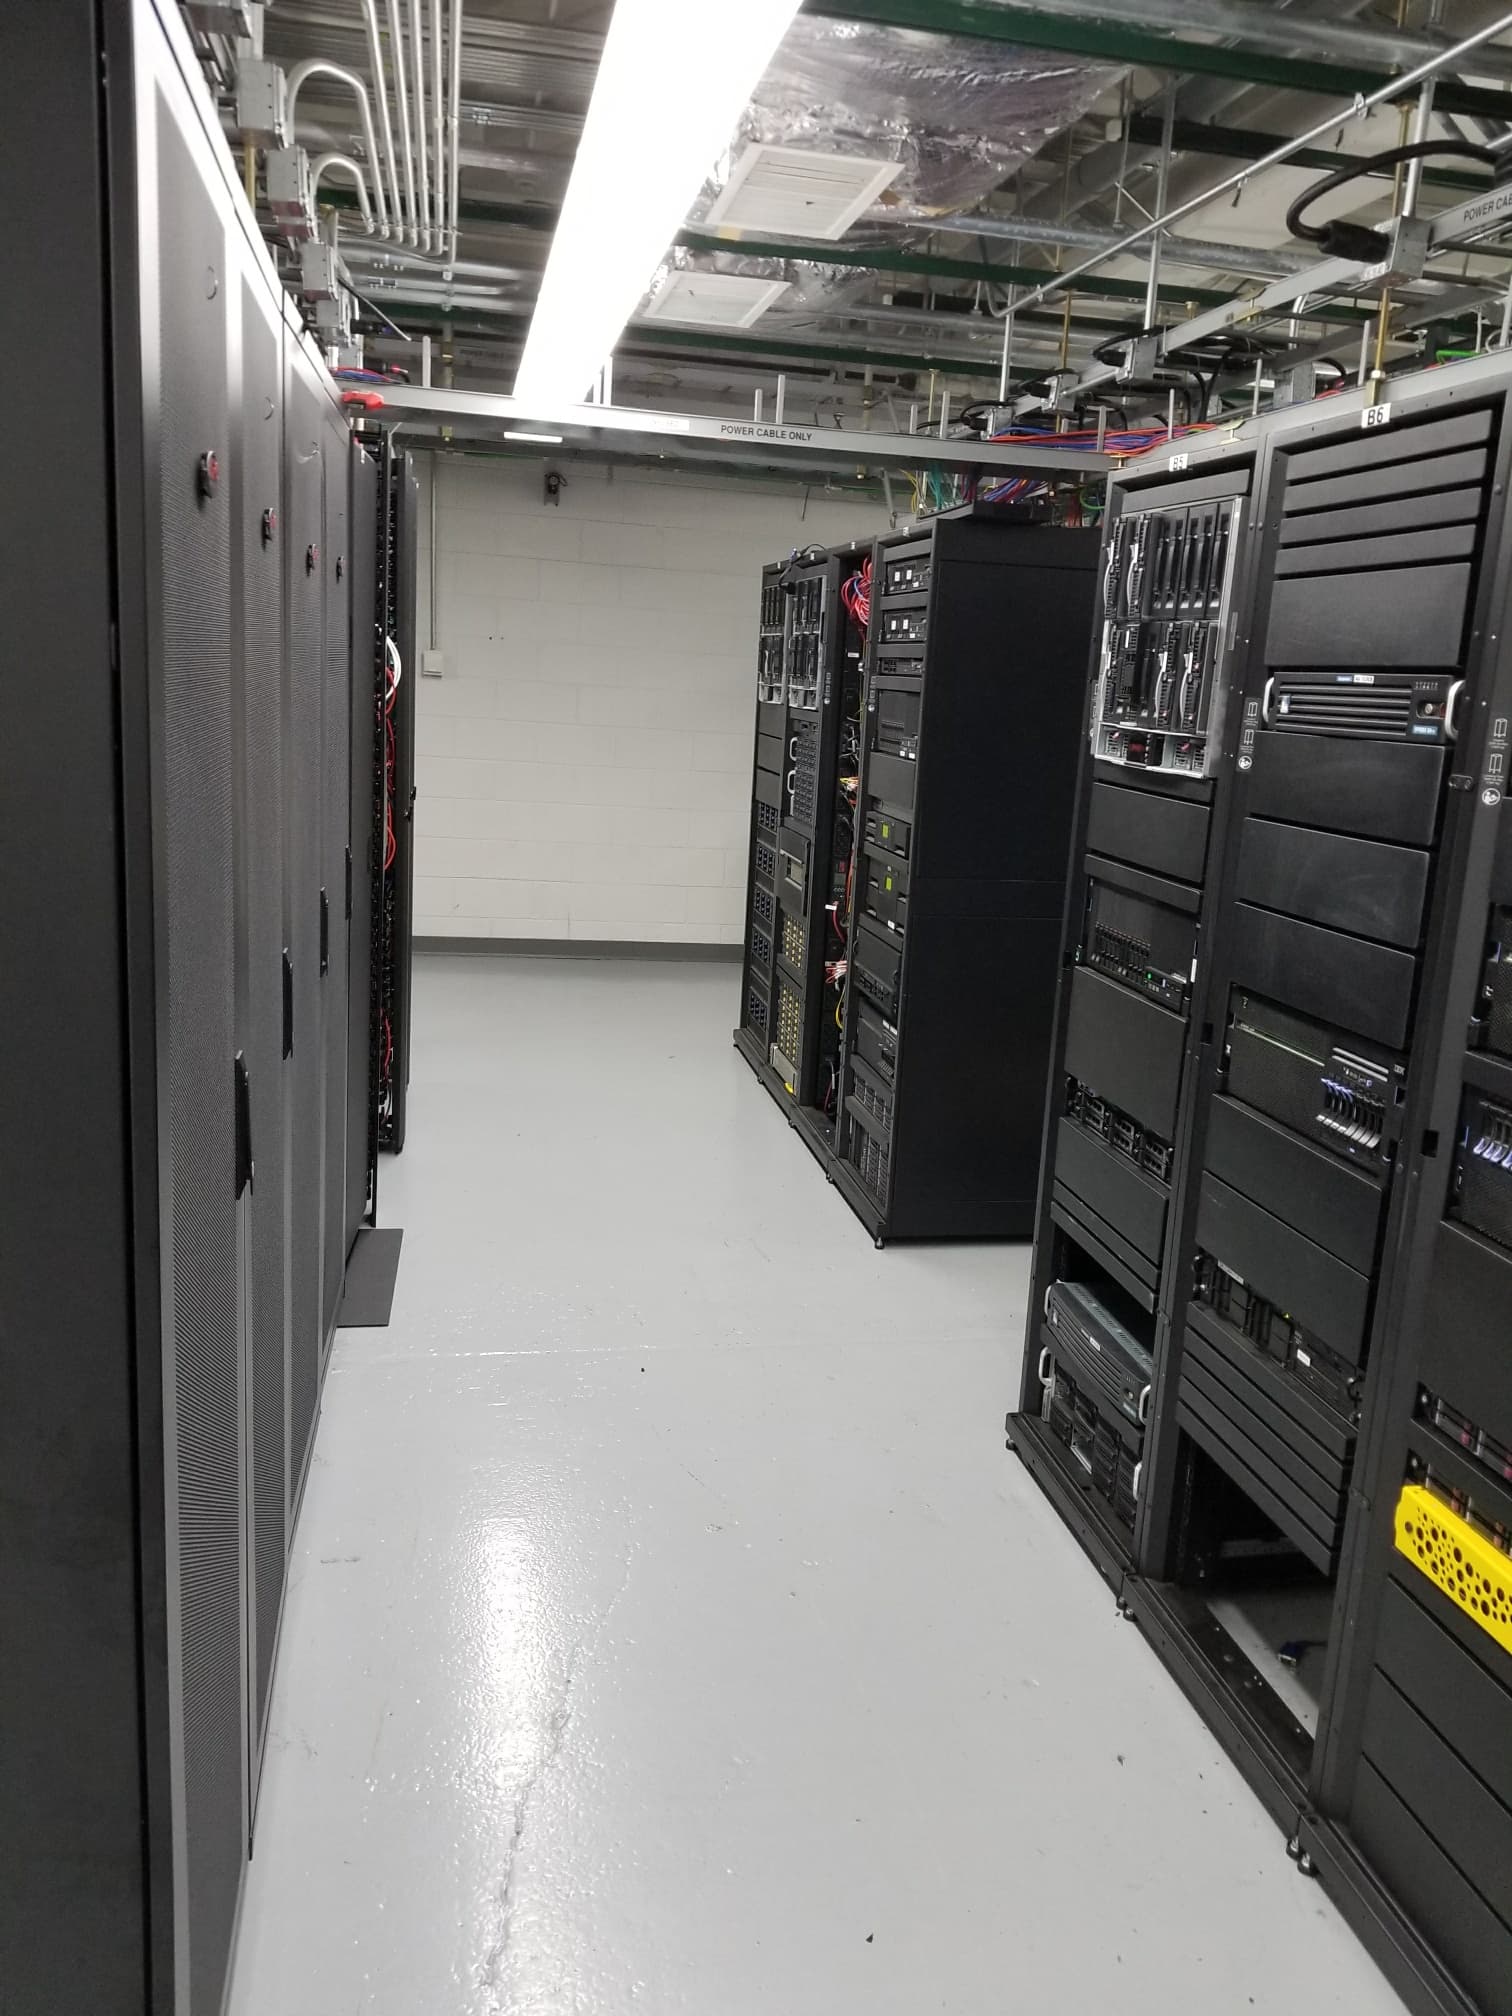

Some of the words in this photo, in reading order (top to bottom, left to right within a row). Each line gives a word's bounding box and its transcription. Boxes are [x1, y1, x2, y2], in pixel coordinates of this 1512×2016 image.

[1464, 200, 1494, 222] POWER
[1367, 407, 1384, 426] B6
[721, 425, 754, 436] POWER
[756, 428, 787, 439] CABLE
[788, 431, 813, 442] ONLY
[1173, 456, 1184, 471] B5
